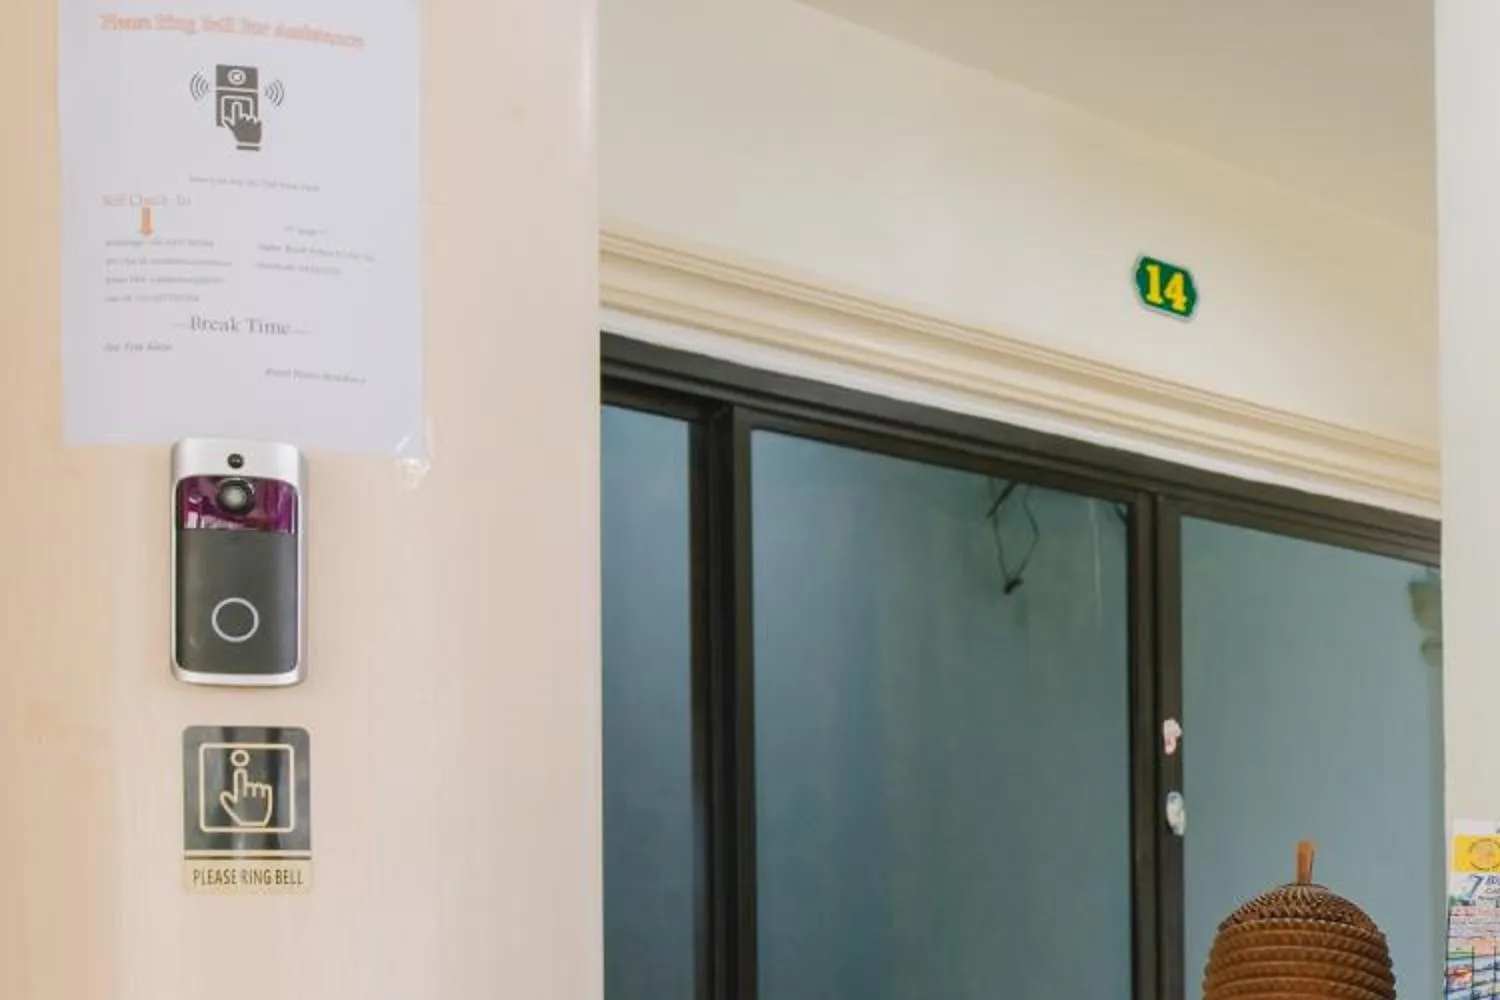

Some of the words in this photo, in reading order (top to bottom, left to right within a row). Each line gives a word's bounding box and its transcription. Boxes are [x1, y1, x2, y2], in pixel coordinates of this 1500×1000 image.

[1145, 263, 1188, 312] 14
[190, 314, 240, 332] Break
[244, 316, 292, 335] Time
[192, 868, 238, 886] PLEASE
[241, 868, 272, 885] RING
[275, 868, 304, 885] BELL
